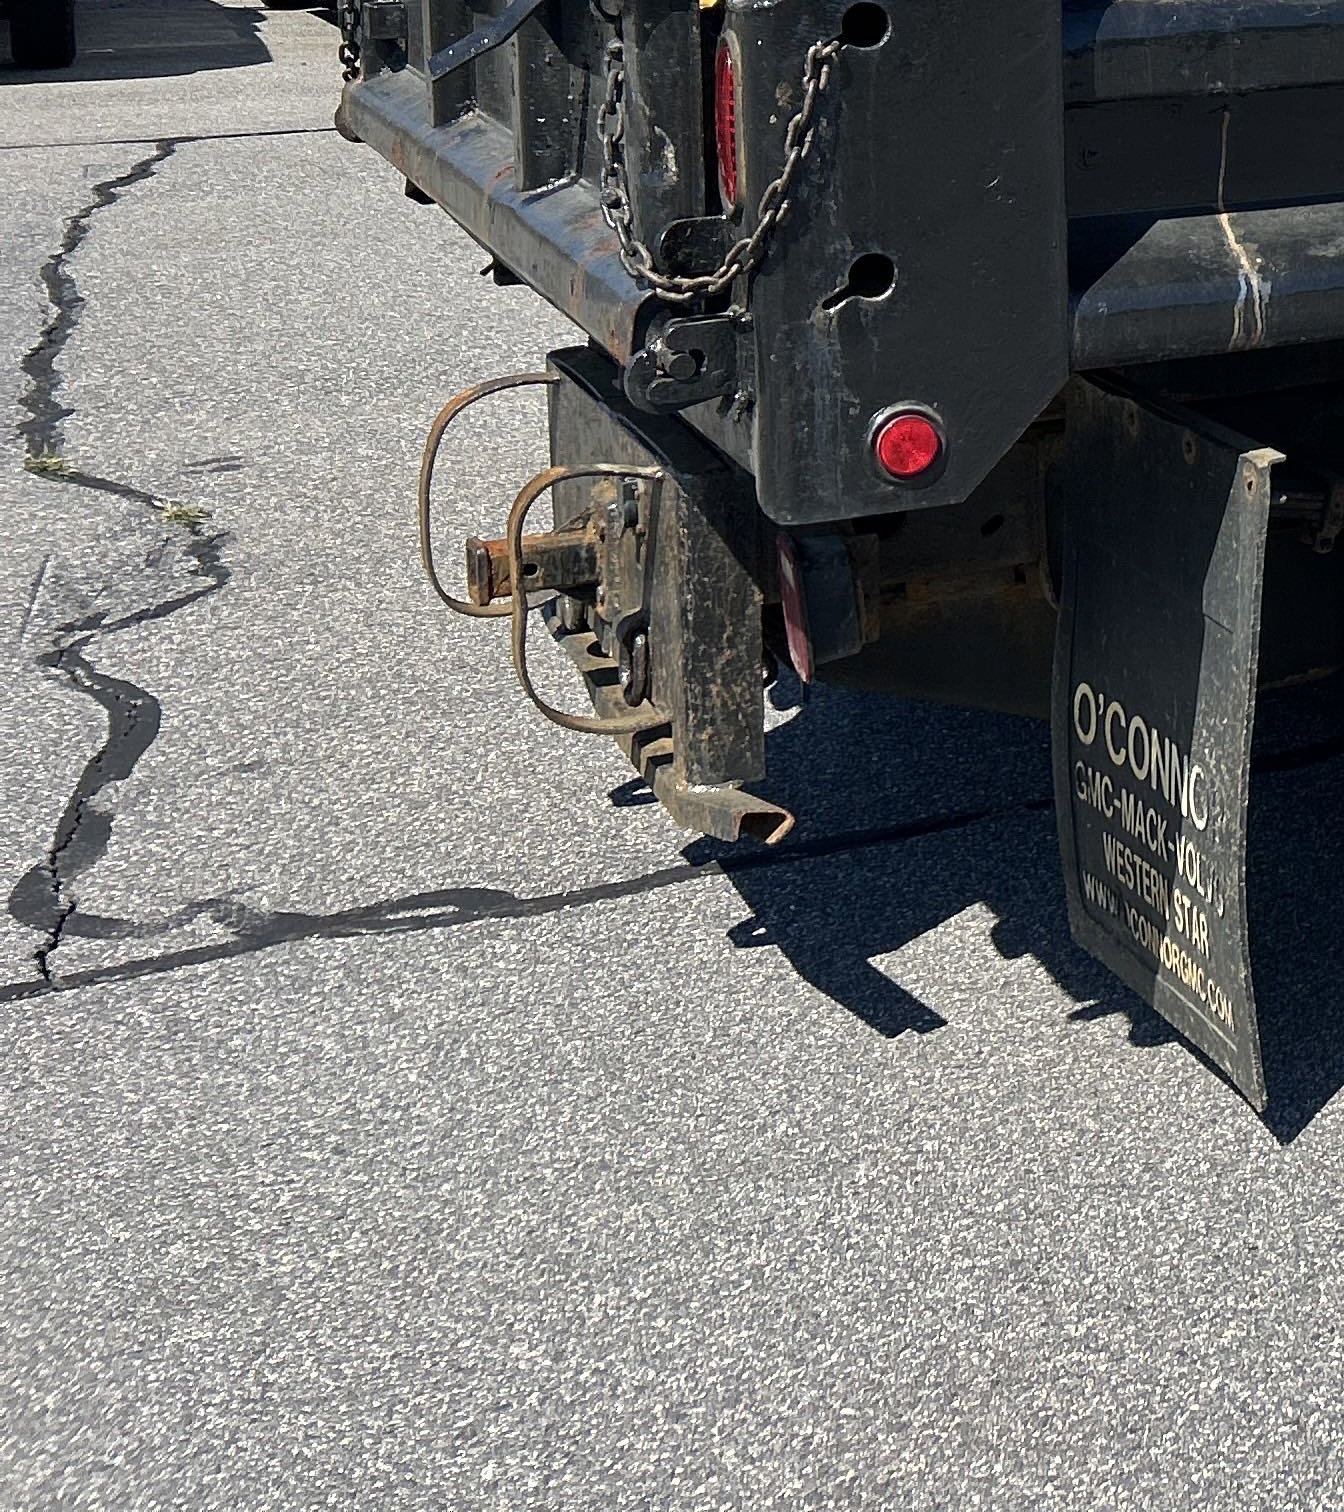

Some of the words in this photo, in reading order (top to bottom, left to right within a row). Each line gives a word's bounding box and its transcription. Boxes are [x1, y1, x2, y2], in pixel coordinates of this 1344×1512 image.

[1083, 870, 1236, 1032] WWWCONNORGMC.COM
[1103, 831, 1170, 921] WESTERN
[1173, 888, 1211, 959] STAR
